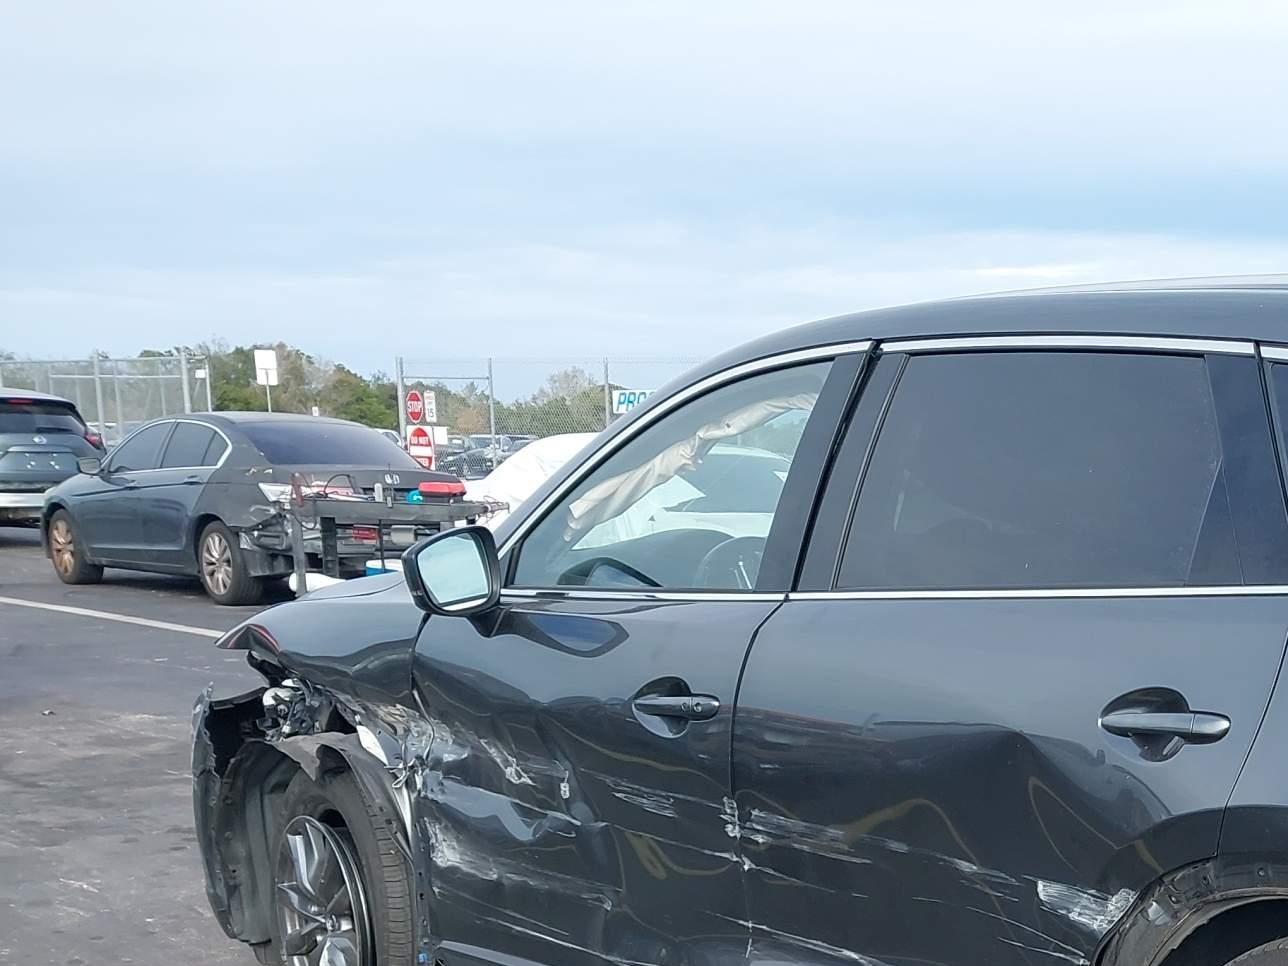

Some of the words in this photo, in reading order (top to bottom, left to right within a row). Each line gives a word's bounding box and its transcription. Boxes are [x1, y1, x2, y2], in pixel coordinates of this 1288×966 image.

[408, 400, 422, 412] STOP
[427, 408, 435, 418] 15
[411, 436, 418, 444] DO
[418, 436, 429, 445] NOT
